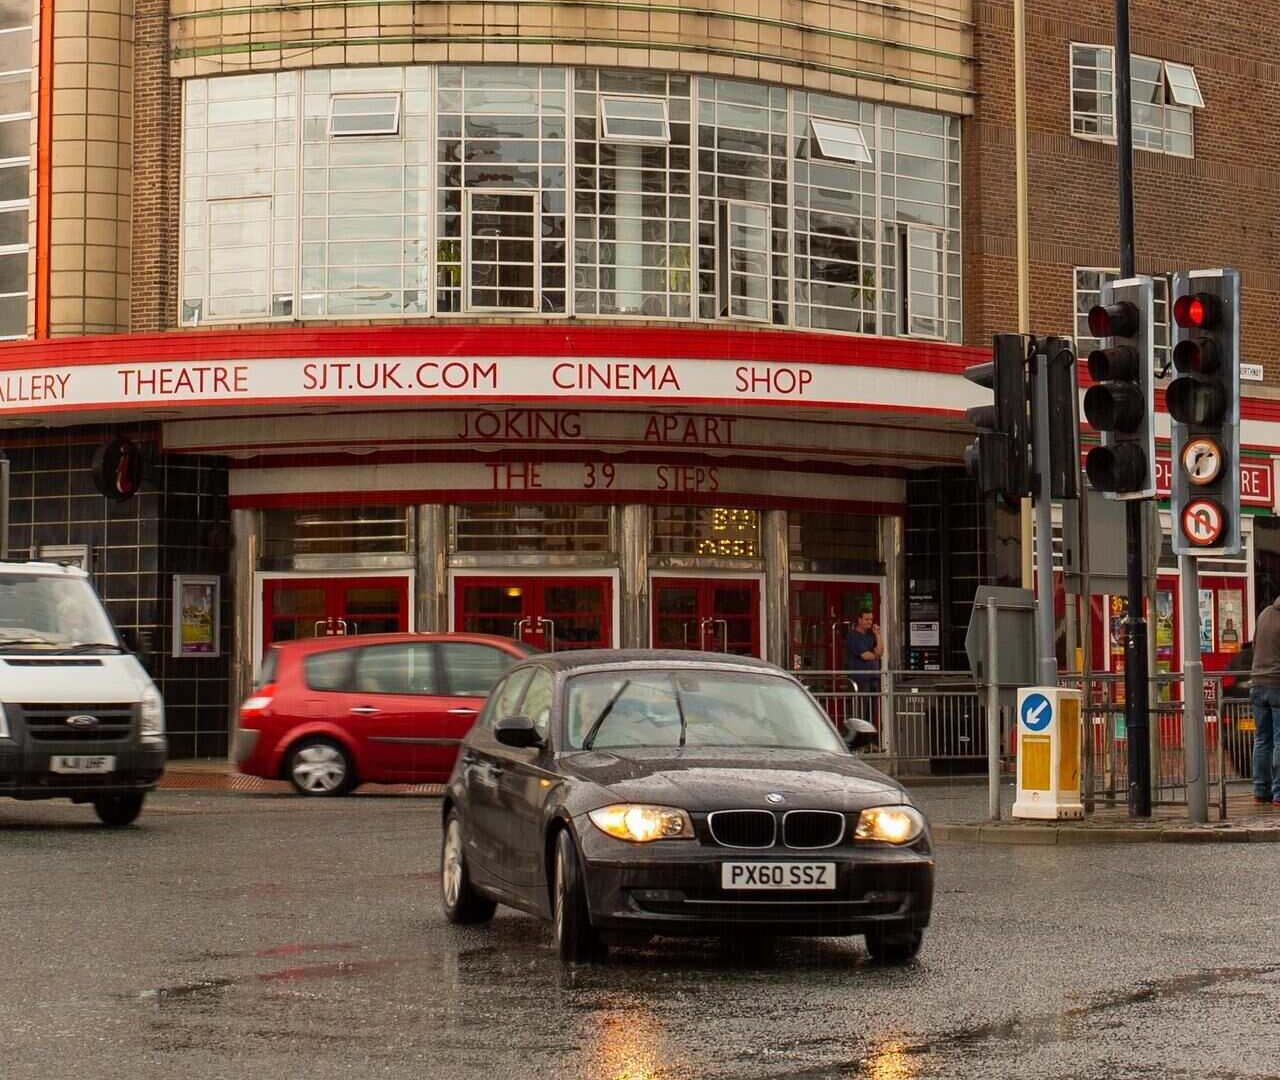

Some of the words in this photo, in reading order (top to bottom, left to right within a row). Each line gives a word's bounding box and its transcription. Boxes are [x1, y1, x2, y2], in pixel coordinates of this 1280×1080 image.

[117, 365, 249, 396] THEATRE
[302, 362, 498, 391] SJT.UK.COM
[551, 362, 681, 392] CINEMA
[734, 366, 814, 395] SHOP
[458, 410, 582, 440] JOKING
[644, 415, 738, 445] APART
[485, 461, 543, 490] THE
[583, 462, 616, 489] 39
[656, 466, 719, 492] STEPS
[731, 865, 784, 885] PX60
[789, 865, 827, 885] SSZ
